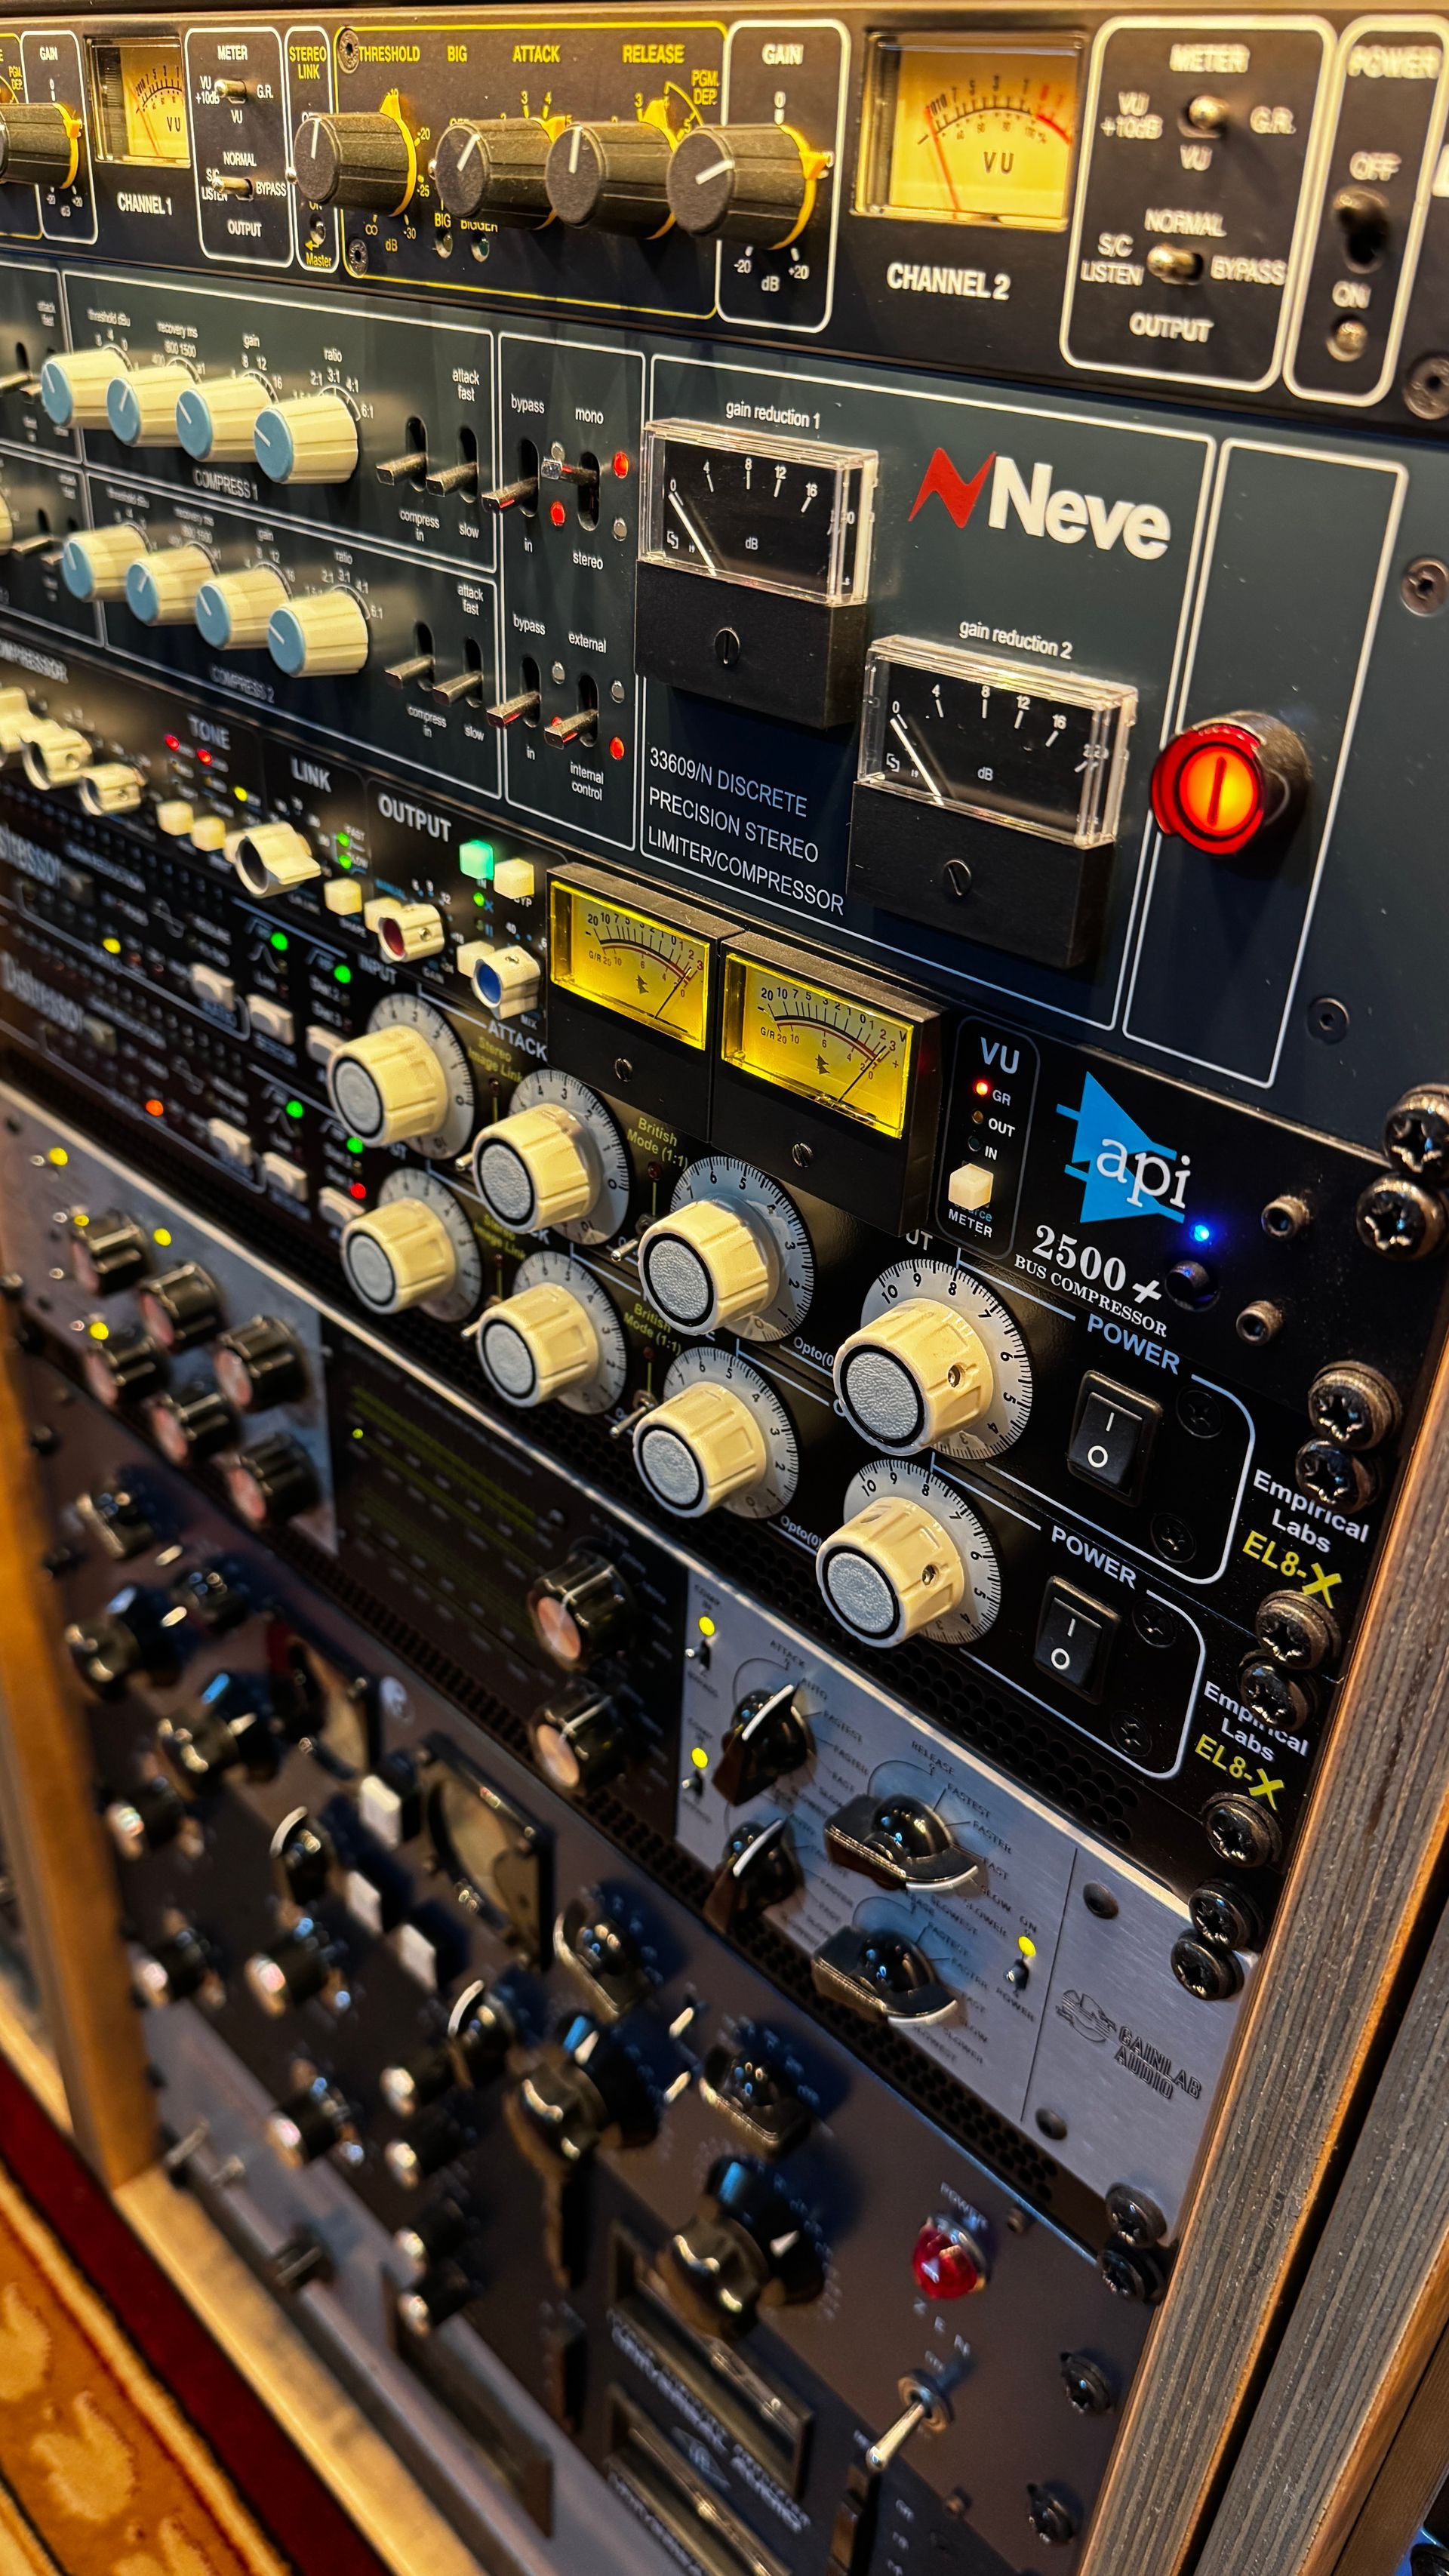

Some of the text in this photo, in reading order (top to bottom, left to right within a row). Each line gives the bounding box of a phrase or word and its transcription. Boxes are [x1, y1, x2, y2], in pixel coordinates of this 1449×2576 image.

[40, 47, 58, 60] GAIN
[217, 45, 248, 61] METER
[289, 46, 327, 63] STEREO
[359, 45, 420, 62] THRESHOLD
[447, 45, 467, 63] BIG
[512, 45, 560, 63] ATTACK
[622, 44, 685, 64] RELEASE
[761, 44, 804, 66] GAIN
[1170, 43, 1251, 73] METER
[1347, 45, 1442, 79] POWER
[200, 75, 212, 91] VU
[297, 63, 320, 80] LINK
[691, 69, 719, 88] PGM.
[257, 85, 274, 100] G.R.
[694, 88, 718, 106] DEP.
[1118, 91, 1150, 117] VU
[166, 116, 180, 132] VU
[231, 109, 243, 124] VU
[1250, 106, 1297, 134] G.R.
[223, 152, 257, 168] NORMAL
[983, 151, 1015, 174] VU
[1180, 144, 1213, 171] VU
[1349, 151, 1402, 181] OFF
[202, 186, 229, 202] LISTEN
[255, 180, 288, 198] BYPASS
[117, 192, 165, 215] CHANNEL
[228, 219, 262, 239] OUTPUT
[435, 212, 451, 228] BIG
[1144, 208, 1228, 239] NORMAL
[385, 239, 398, 253] dB
[306, 251, 332, 269] Master
[1210, 255, 1288, 286] BYPASS
[761, 275, 780, 292] dB
[789, 265, 810, 280] +20
[887, 261, 1011, 300] CHANNEL 2
[1080, 260, 1145, 287] LISTEN
[1332, 280, 1372, 309] ON
[1129, 312, 1215, 343] OUTPUT
[243, 334, 260, 349] gain
[324, 347, 343, 363] ratio
[452, 368, 480, 386] attack
[457, 384, 475, 402] fast
[510, 394, 545, 414] bypass
[575, 407, 604, 425] mono
[726, 399, 821, 430] gain reduction 1
[192, 467, 251, 500] COMPRESS
[774, 465, 819, 498] 12 16
[398, 509, 441, 530] compress
[988, 455, 1171, 561] Neve
[415, 527, 426, 543] in
[458, 522, 480, 540] slow
[524, 537, 534, 553] in
[745, 537, 759, 551] dB
[334, 549, 353, 565] ratio
[572, 550, 605, 571] stereo
[457, 581, 485, 603] attack
[462, 599, 480, 617] fast
[512, 611, 546, 636] bypass
[568, 630, 607, 654] external
[959, 619, 1074, 660] gain reduction 2
[406, 703, 448, 729] compress
[1016, 694, 1067, 731] 12 16
[187, 713, 231, 752] TONE
[423, 724, 433, 739] in
[463, 723, 485, 742] slow
[525, 743, 536, 761] in
[291, 758, 332, 793] LINK
[570, 761, 605, 786] internal
[650, 746, 808, 819] 33609/N DISCRETE
[977, 766, 995, 782] dB
[571, 780, 603, 802] control
[378, 792, 452, 843] OUTPUT
[649, 786, 820, 863] PRECISION STEREO
[648, 825, 844, 916] LIMITER/COMPRESSOR
[589, 949, 601, 963] G/R
[761, 986, 788, 1002] 20 10
[488, 1020, 549, 1063] ATTACK
[760, 1026, 775, 1041] G/R
[478, 1036, 512, 1063] Stereo
[980, 1036, 1020, 1075] VU
[500, 1062, 524, 1083] Link
[992, 1089, 1011, 1107] GR
[637, 1116, 679, 1147] British
[988, 1117, 1016, 1138] OUT
[626, 1128, 689, 1171] Mode (1:1)
[985, 1145, 998, 1161] IN
[1096, 1137, 1192, 1210] api
[948, 1208, 993, 1238] METER
[881, 1283, 899, 1305] 10
[1014, 1253, 1168, 1339] BUS COMPRESSOR
[623, 1311, 654, 1338] Mode
[633, 1303, 674, 1334] British
[792, 1336, 835, 1367] Opto(0
[1087, 1313, 1181, 1375] POWER
[1253, 1468, 1371, 1543] Empirical
[1271, 1508, 1331, 1553] Labs
[1051, 1525, 1137, 1590] POWER
[1242, 1529, 1343, 1610] EL8-X
[1221, 1717, 1275, 1763] Labs
[911, 1740, 955, 1777] RELEASE
[1195, 1733, 1284, 1811] EL8-X
[946, 1782, 992, 1820] FASTEST
[972, 1820, 1014, 1855] FASTER
[982, 1856, 1010, 1882] FAST
[981, 1885, 1013, 1914] SLOW
[1113, 2045, 1175, 2101] AUDIO
[1118, 2025, 1203, 2101] GAINLAB
